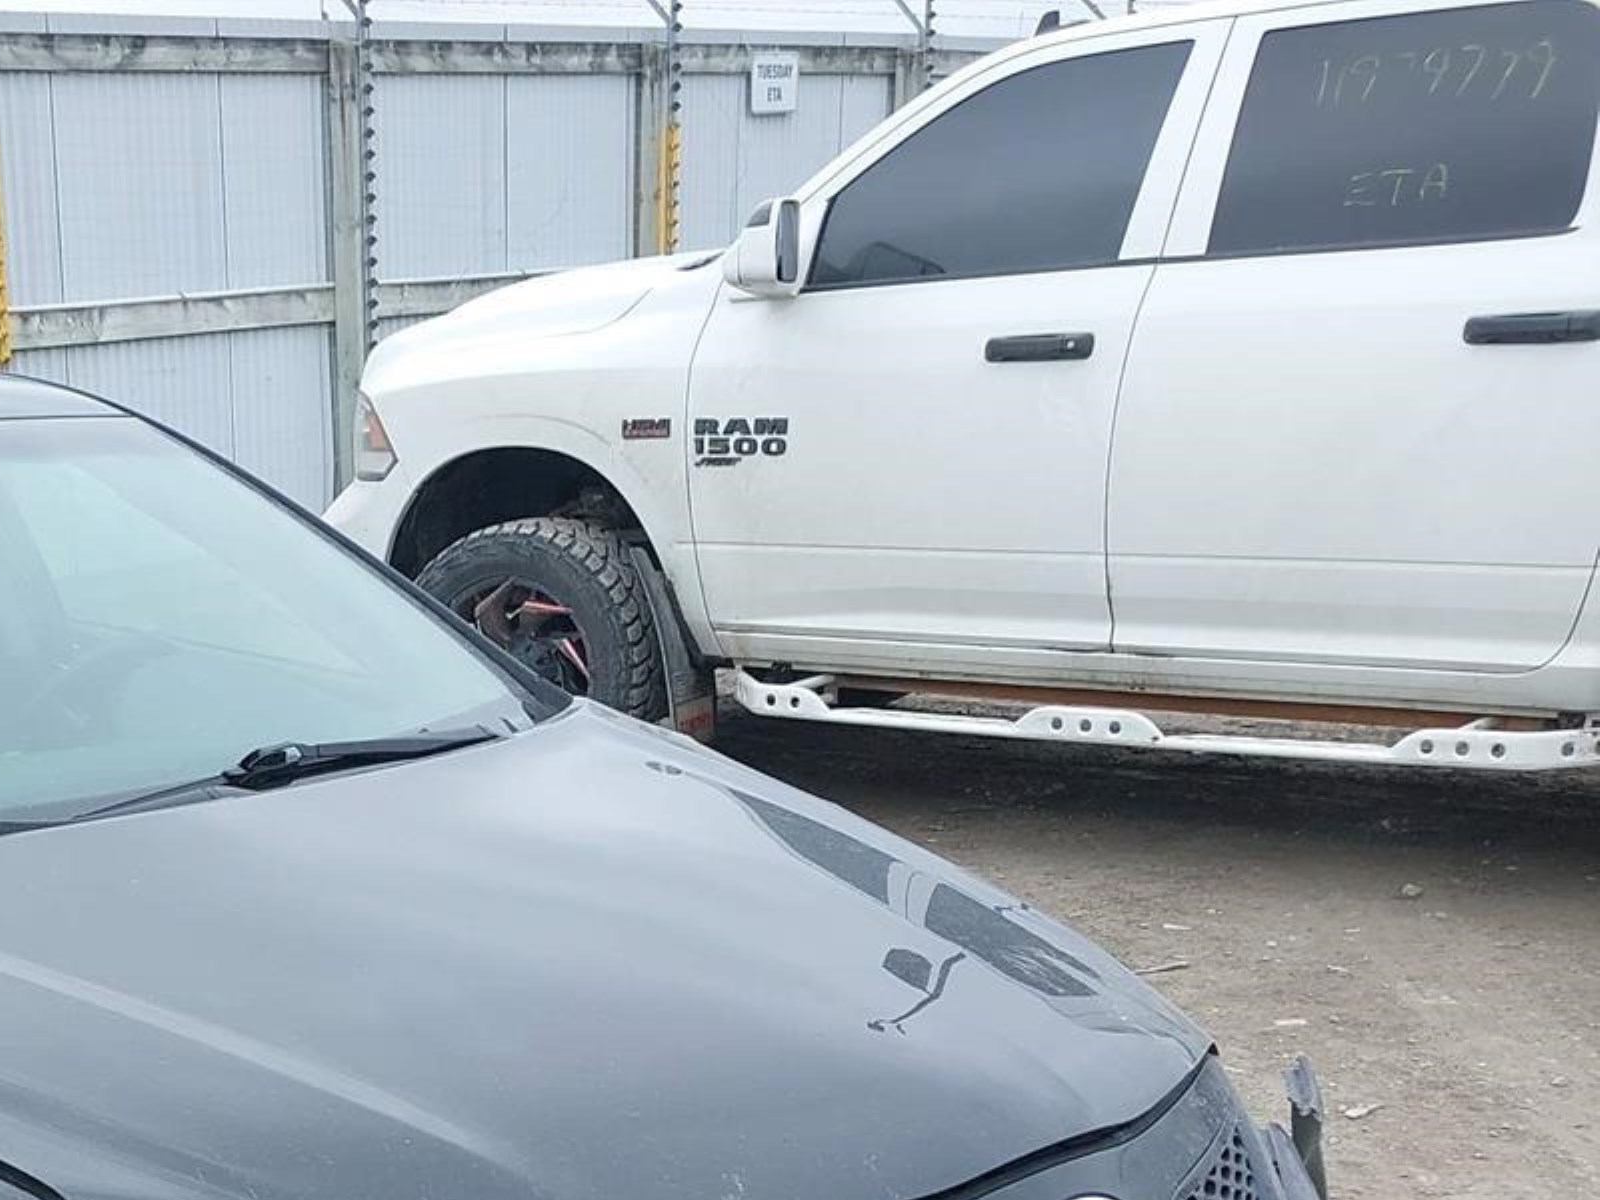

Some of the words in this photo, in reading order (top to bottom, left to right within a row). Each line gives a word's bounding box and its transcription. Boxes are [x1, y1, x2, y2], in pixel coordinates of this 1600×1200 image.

[1342, 163, 1450, 207] ETA
[693, 418, 789, 436] RAM
[693, 438, 787, 456] 1500
